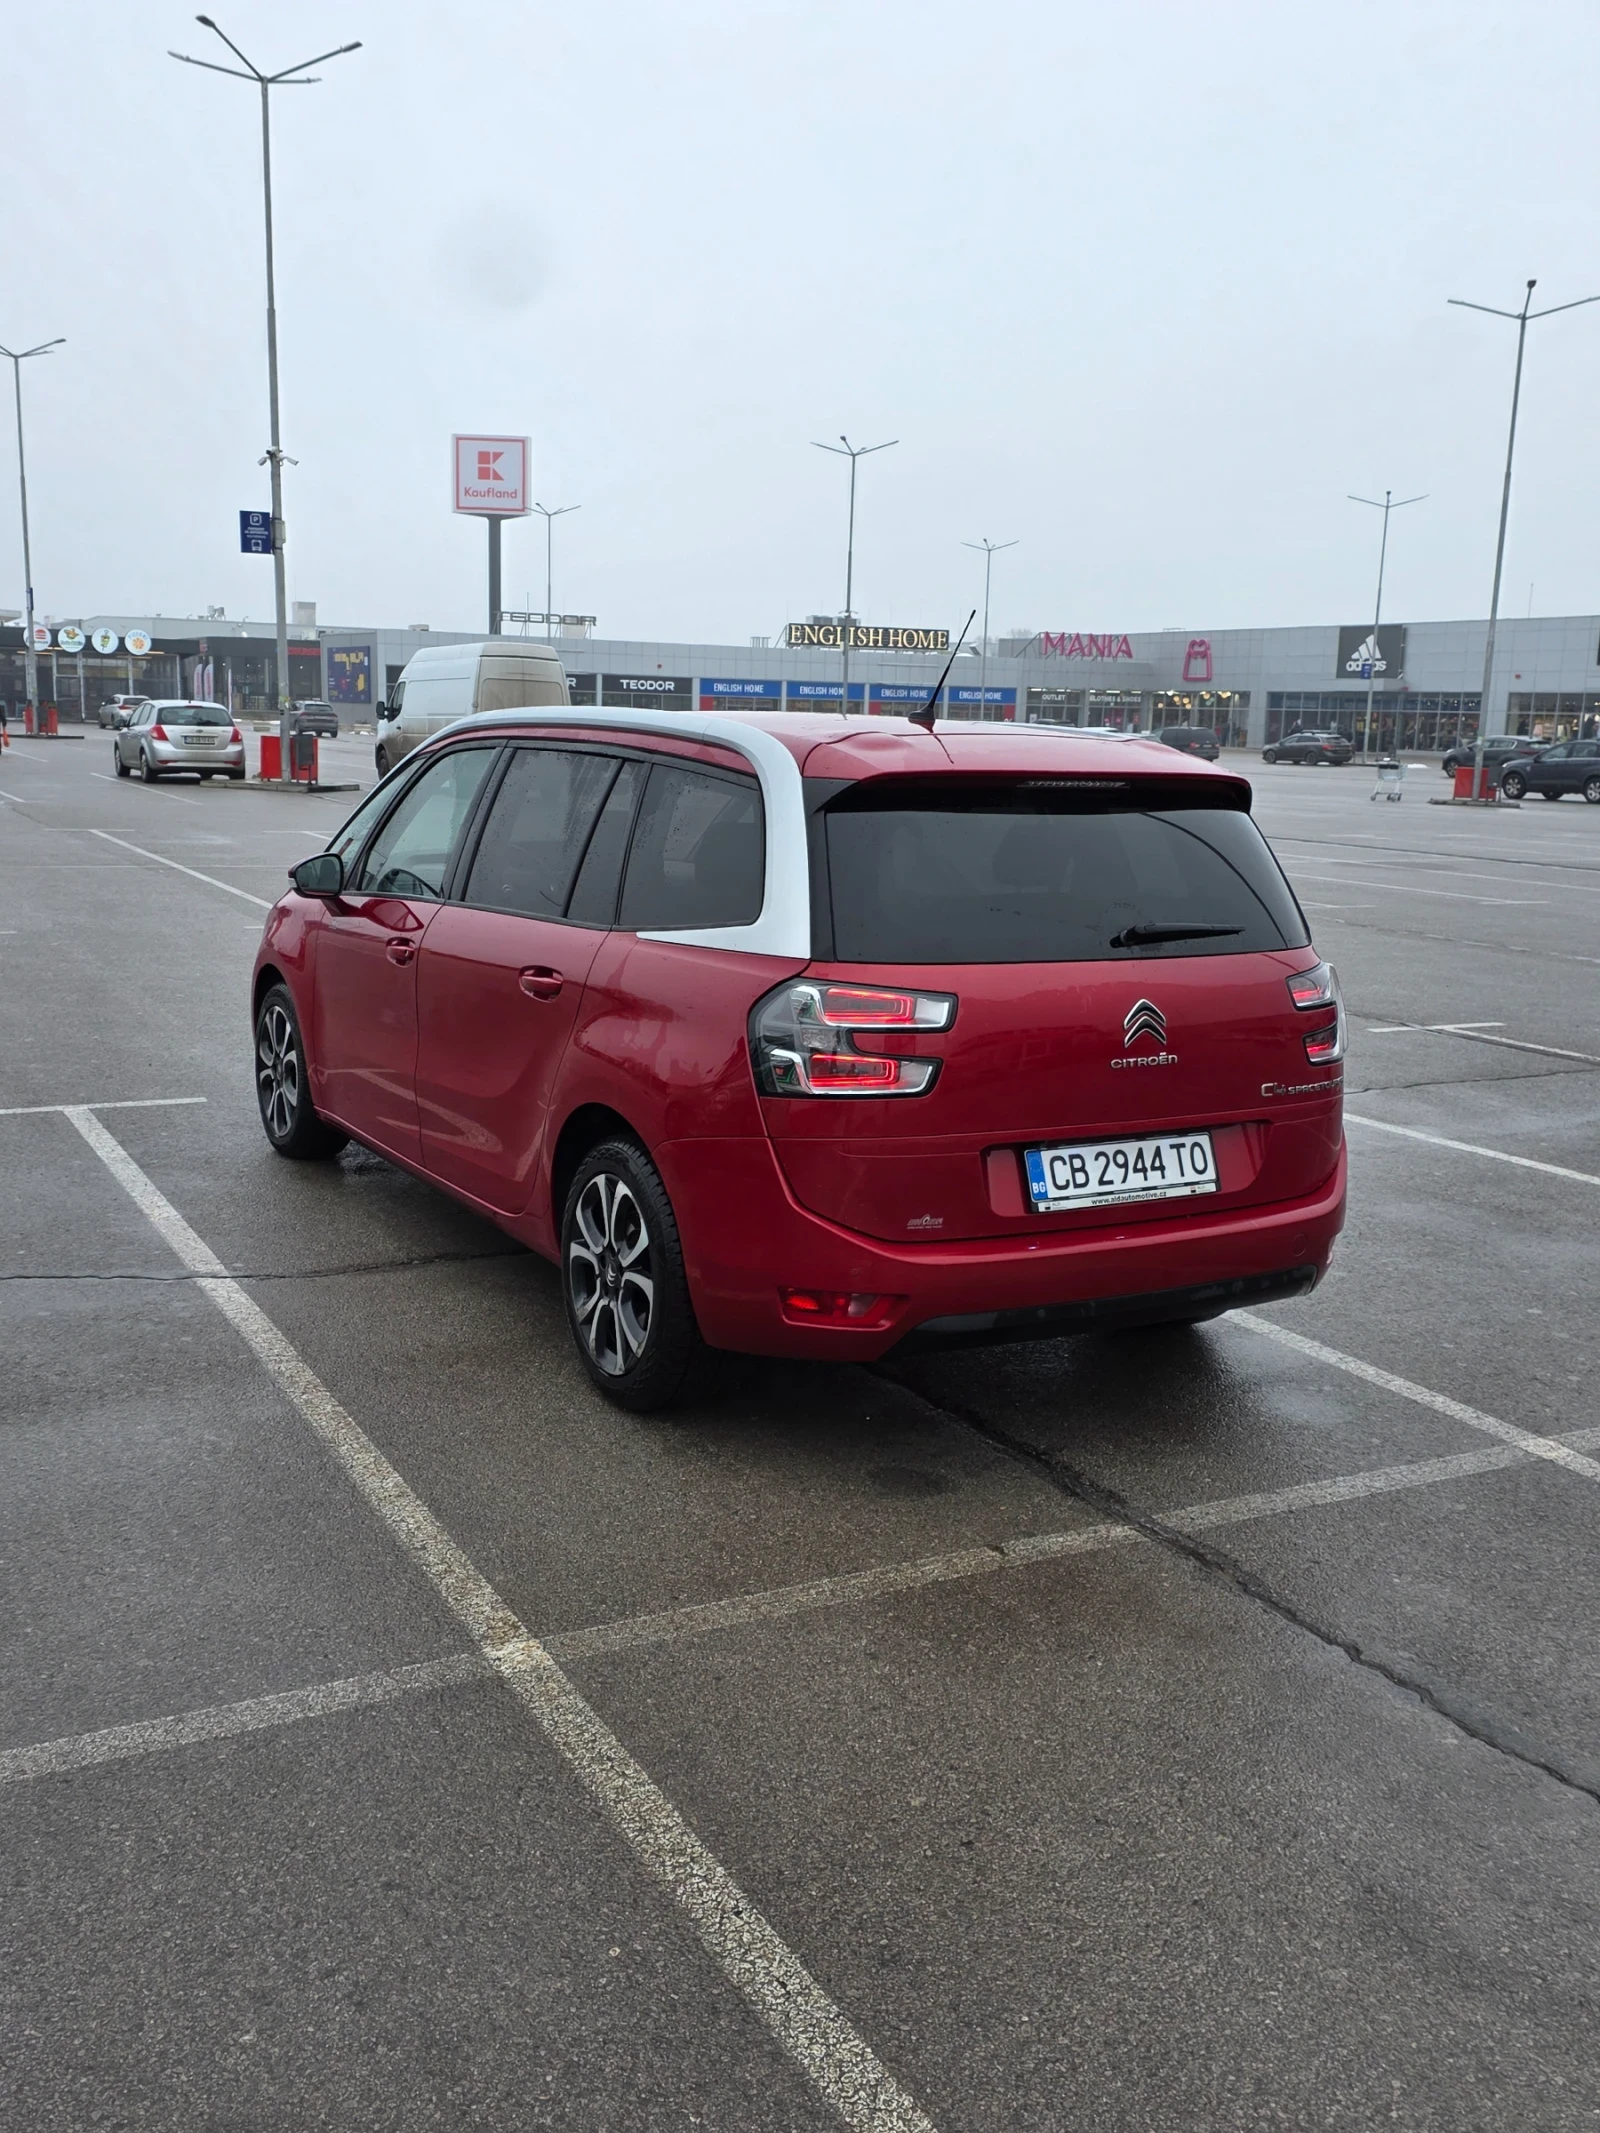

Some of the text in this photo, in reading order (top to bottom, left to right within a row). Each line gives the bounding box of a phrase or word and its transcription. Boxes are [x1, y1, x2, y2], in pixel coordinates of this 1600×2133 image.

[464, 486, 518, 499] Kaufland
[790, 625, 948, 649] ENGLISH HOME
[1043, 631, 1133, 659] MANIA
[1346, 658, 1387, 671] adas
[620, 679, 675, 691] TEODOR
[713, 683, 764, 693] ENGLISH HOME
[800, 686, 845, 696] ENGLISH HOM
[881, 688, 928, 698] ENGLISH HOME
[984, 691, 1002, 700] HOME
[1050, 1141, 1208, 1191] CB 2944 TO
[1032, 1181, 1046, 1193] BG
[1091, 1191, 1167, 1205] www.aldautomotive.cz
